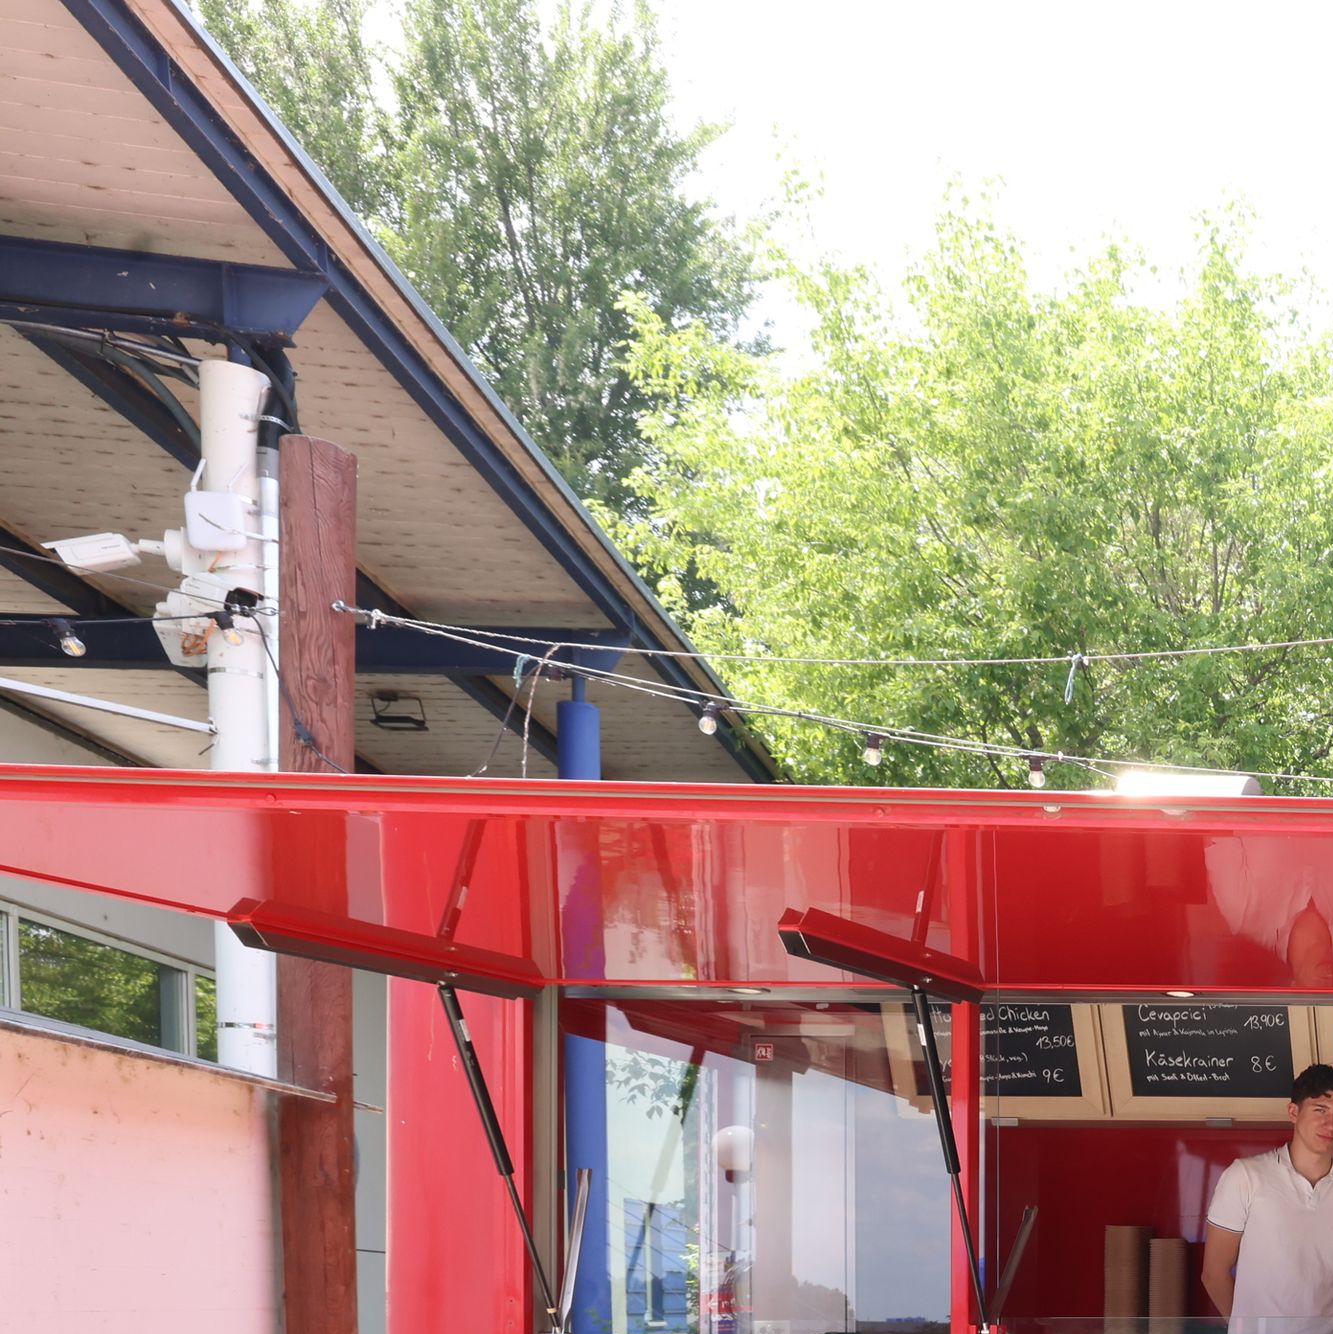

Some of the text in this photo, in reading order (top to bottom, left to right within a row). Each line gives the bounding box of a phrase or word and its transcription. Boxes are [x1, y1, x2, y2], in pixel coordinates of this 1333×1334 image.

[998, 1005, 1050, 1021] Chicken
[1138, 1005, 1285, 1030] Cevapcici 13,90€
[1036, 1035, 1075, 1049] 13,50€
[1145, 1049, 1234, 1068] Käsekrainer
